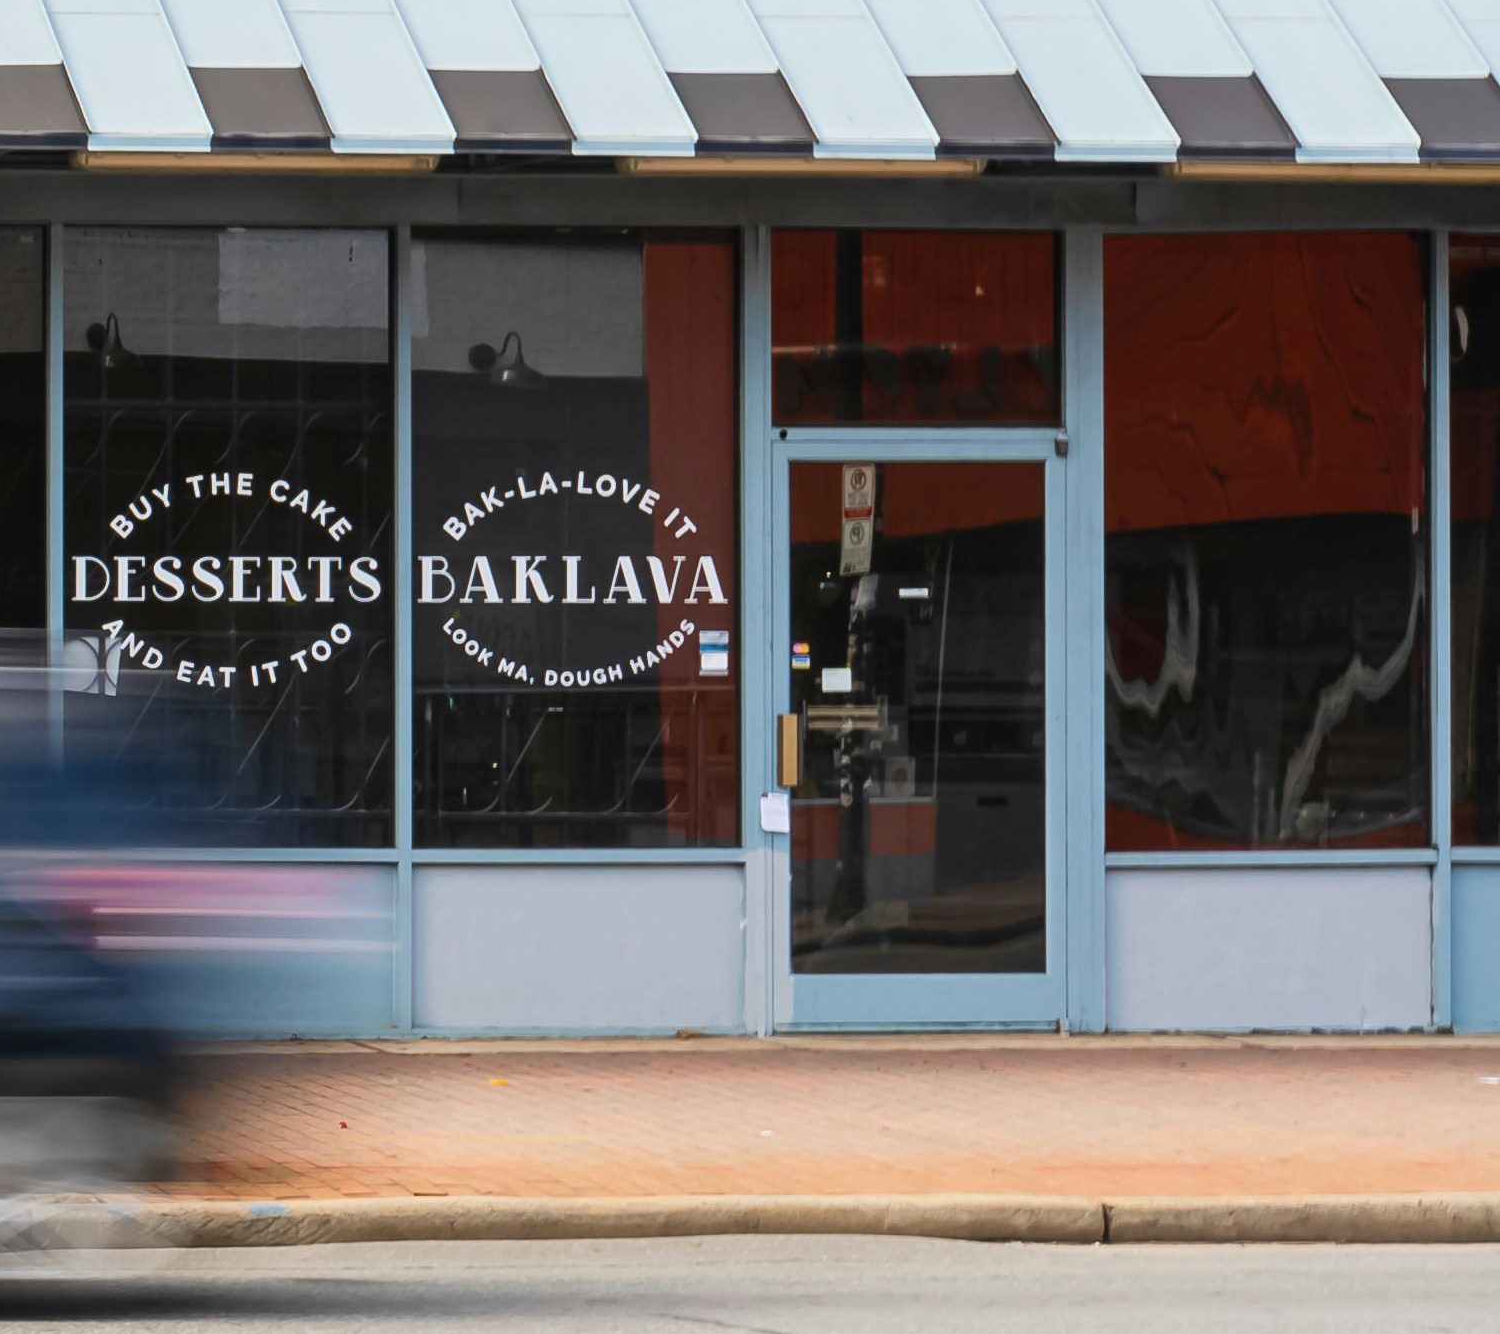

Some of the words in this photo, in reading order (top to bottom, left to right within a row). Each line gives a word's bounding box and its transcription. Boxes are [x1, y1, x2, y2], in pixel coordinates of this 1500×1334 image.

[109, 483, 171, 539] BUY
[185, 472, 254, 498] THE
[270, 479, 353, 542] CAKE
[442, 470, 661, 542] BAK-LA-LOVE
[663, 507, 697, 540] IT
[71, 555, 382, 603] DESSERTS
[417, 555, 729, 604] BAKLAVA
[101, 619, 165, 669] AND
[176, 660, 237, 688] EAT
[250, 660, 279, 687] IT
[290, 622, 352, 673] TOO
[442, 617, 494, 667] LOOK
[497, 657, 535, 685] MA,
[544, 663, 623, 687] DOUGH
[629, 618, 695, 675] HANDS
